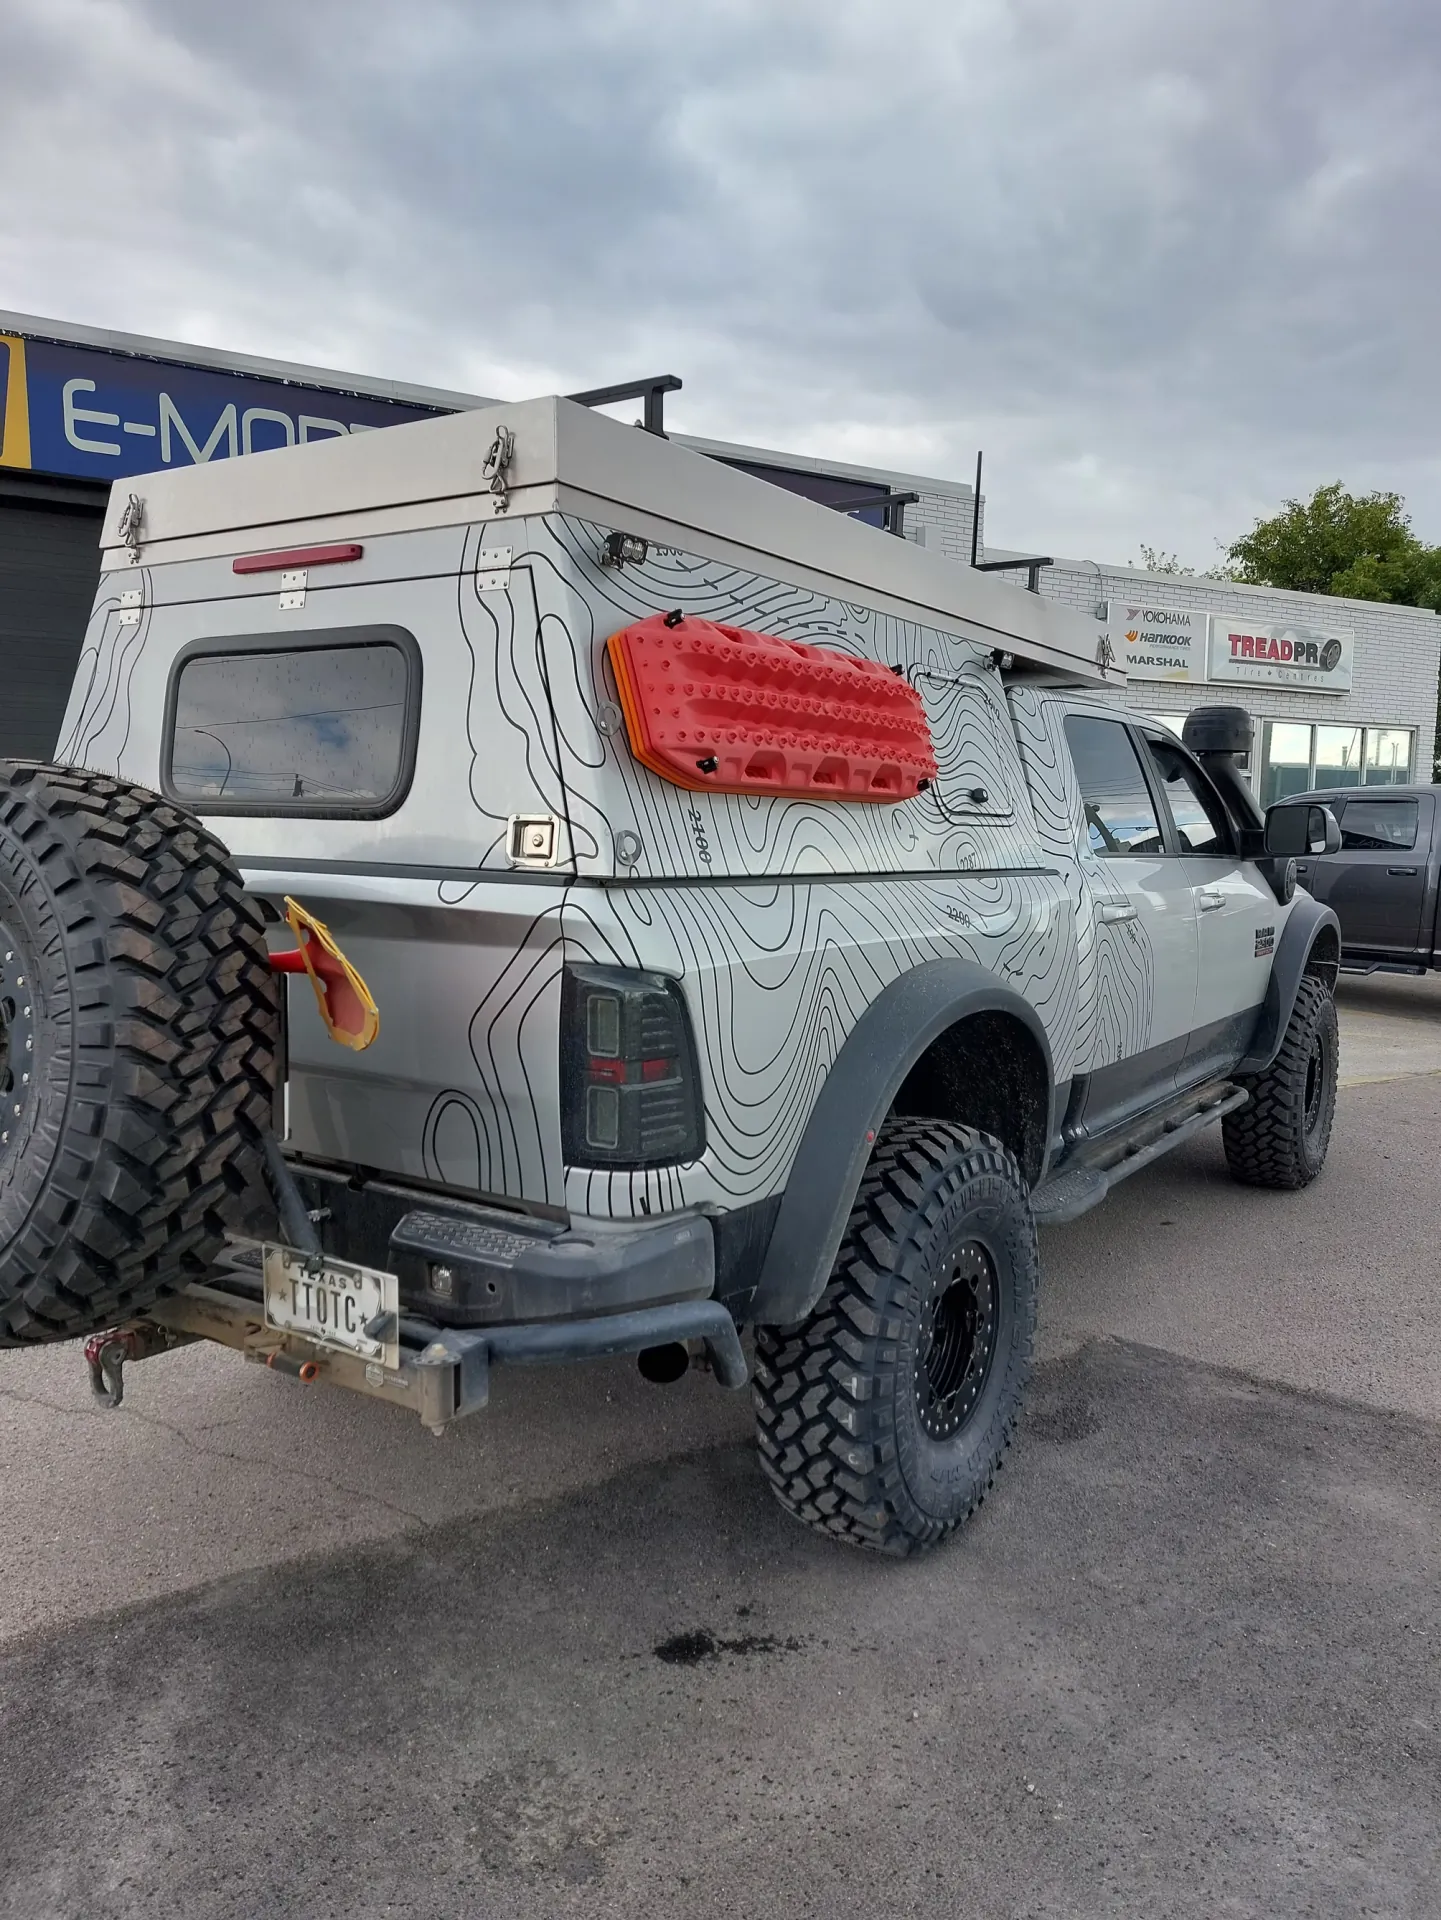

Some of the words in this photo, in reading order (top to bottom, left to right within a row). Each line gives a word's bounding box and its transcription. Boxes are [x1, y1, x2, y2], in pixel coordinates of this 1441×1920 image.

[1142, 610, 1191, 626] YOKOHAMA
[1126, 654, 1189, 668] MARSHAL
[288, 1278, 356, 1334] TTOTC
